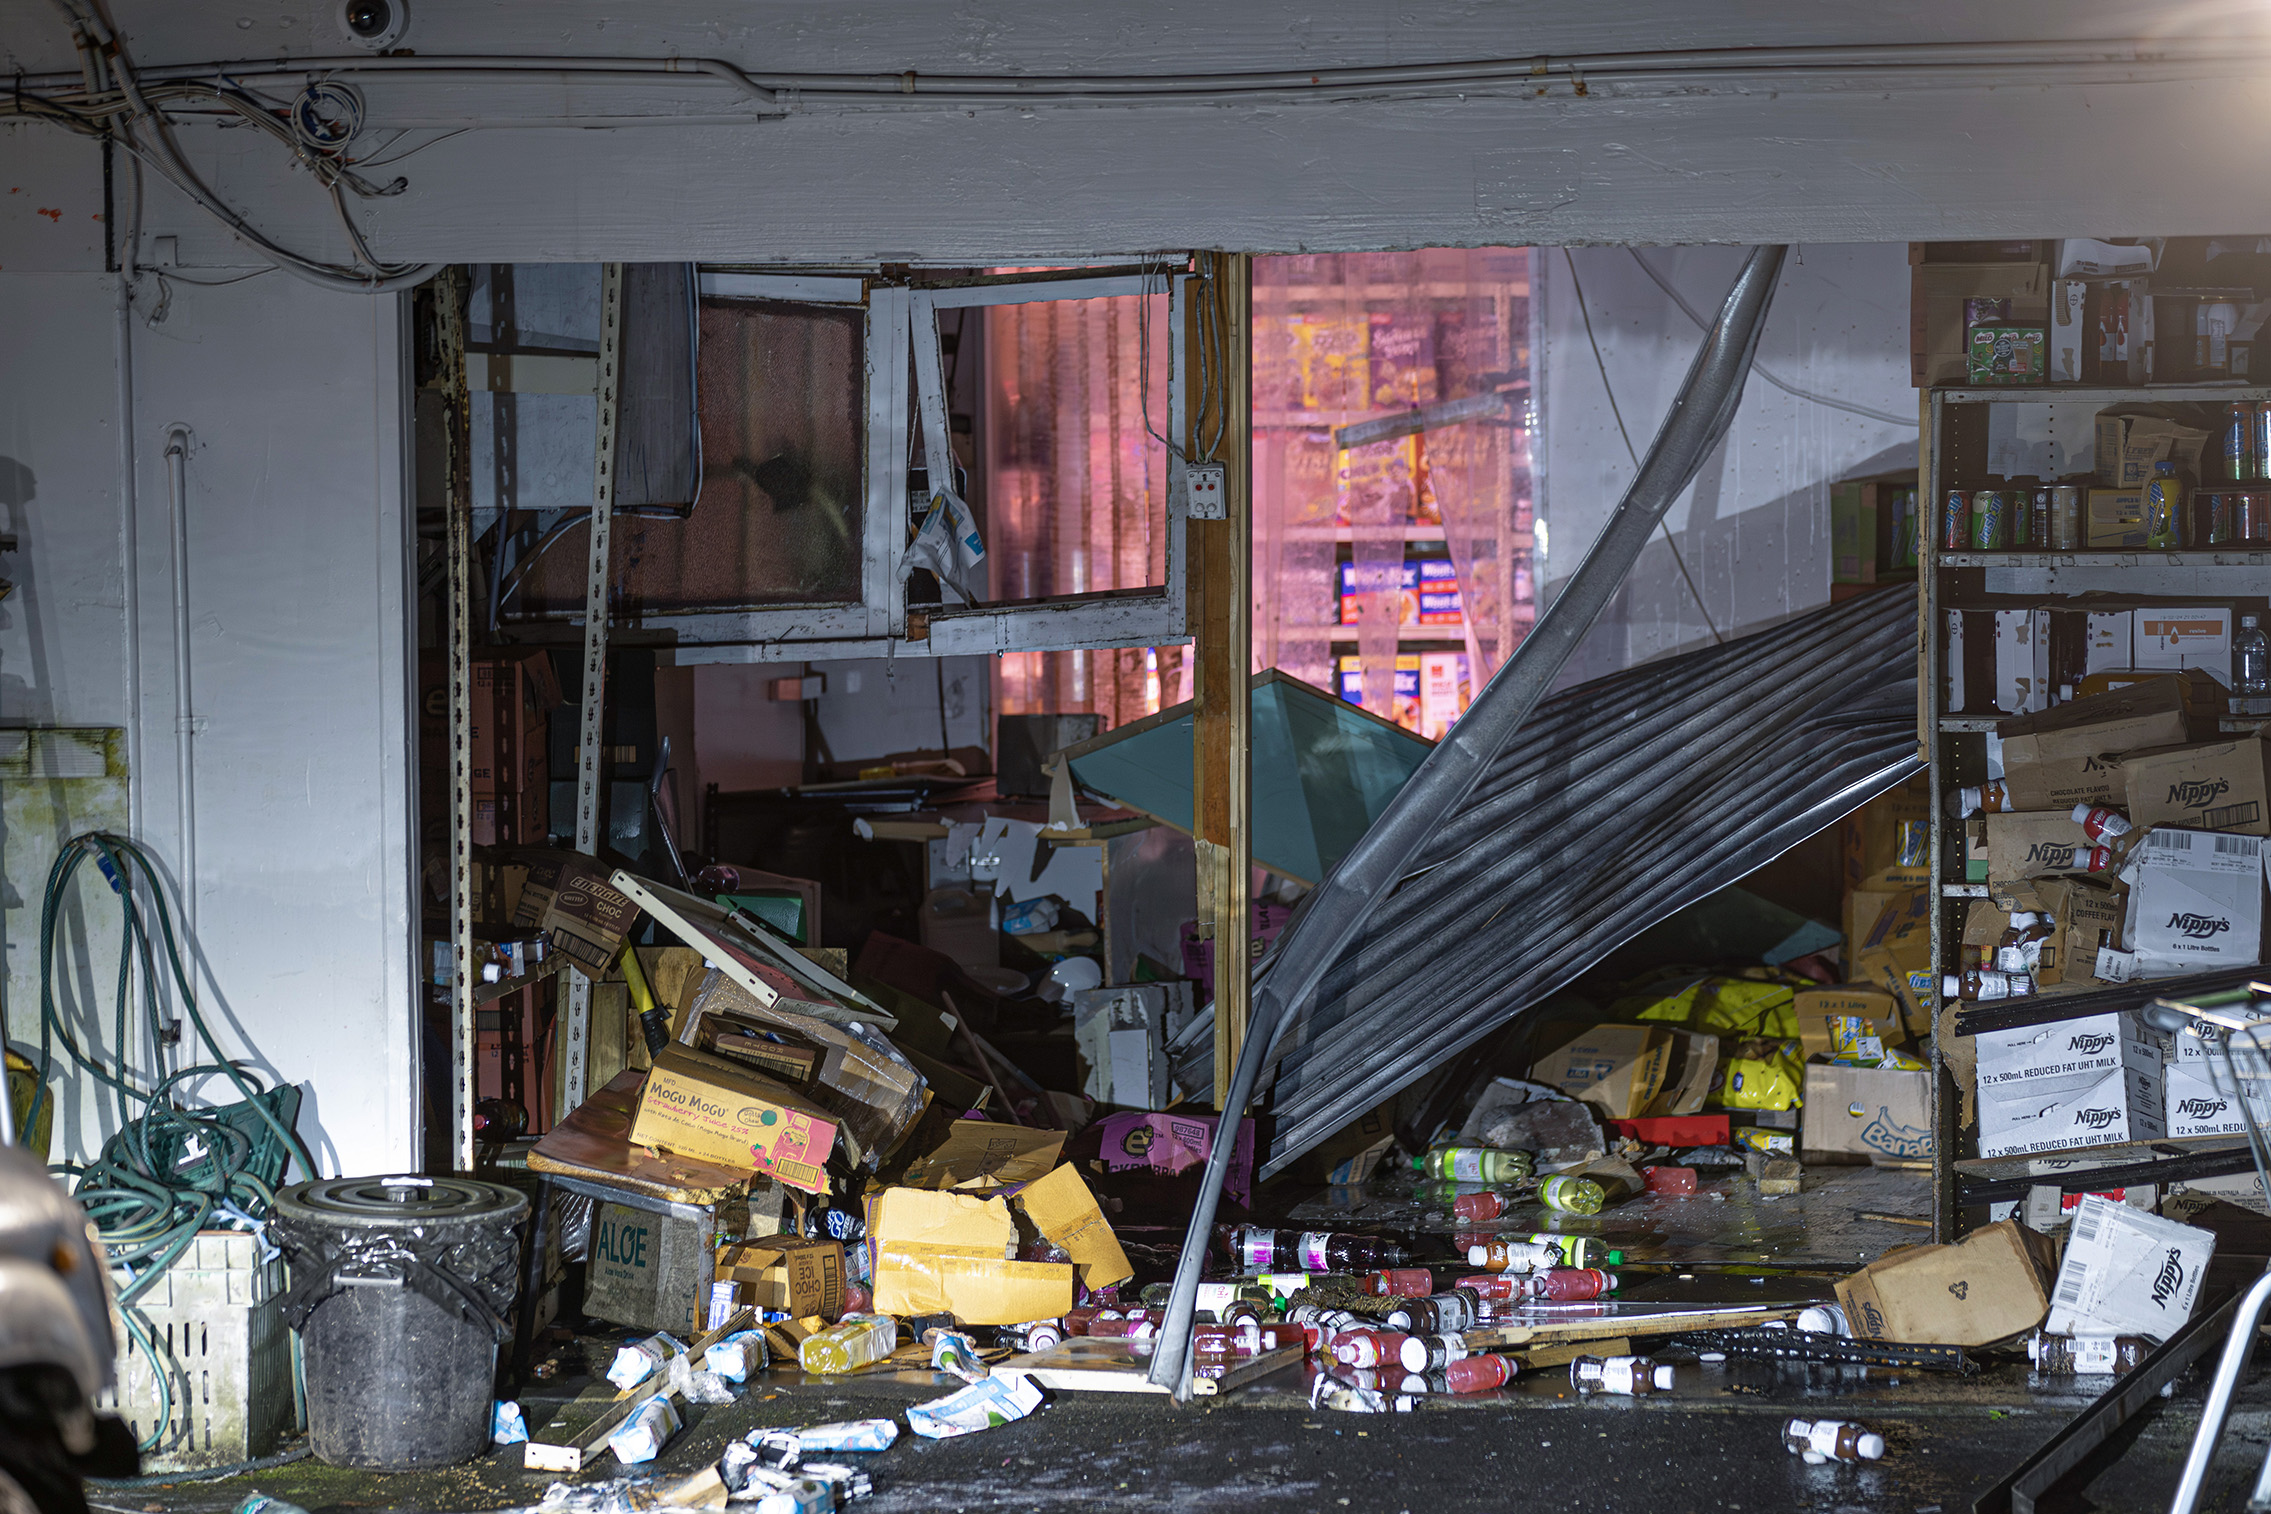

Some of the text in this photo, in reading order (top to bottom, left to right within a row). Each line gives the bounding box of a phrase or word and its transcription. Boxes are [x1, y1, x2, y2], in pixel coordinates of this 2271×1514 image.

[1976, 335, 1993, 343] MILO
[1978, 493, 2003, 545] fresh up
[2050, 788, 2085, 797] CHOCOLATE
[2052, 796, 2079, 804] REDUCED
[2165, 777, 2230, 810] Nippy's
[596, 901, 622, 918] CHOC
[2076, 909, 2100, 919] COFFEE
[2165, 912, 2231, 939] Nippy's
[1819, 1001, 1829, 1009] 12
[1848, 1001, 1867, 1009] Litre
[2067, 1032, 2115, 1056] Nippy's
[2184, 1048, 2191, 1056] 12
[663, 1077, 677, 1086] MFD
[1983, 1075, 1992, 1084] 12
[2000, 1070, 2023, 1083] 500mL
[2024, 1065, 2061, 1078] REDUCED
[2062, 1061, 2076, 1073] FAT
[2078, 1060, 2094, 1071] UHT
[2096, 1057, 2117, 1068] MILK
[646, 1096, 749, 1135] Strawberry Juice 25%
[2074, 1107, 2122, 1130] Nippy's
[2175, 1097, 2228, 1120] Nippy's
[2176, 1126, 2185, 1134] 12
[2194, 1124, 2221, 1134] 500mL
[1987, 1149, 1997, 1158] 12
[2004, 1144, 2028, 1155] 500mL
[2030, 1139, 2068, 1152] REDUCED
[2069, 1136, 2084, 1147] FAT
[2085, 1134, 2102, 1145] UHT
[2103, 1132, 2124, 1143] MILK
[710, 1153, 735, 1163] BOTTLES
[830, 1210, 845, 1239] GO
[597, 1221, 648, 1268] ALOE
[799, 1266, 815, 1280] ICE
[2151, 1246, 2184, 1311] Nippy's
[2186, 1284, 2194, 1297] Litre
[2190, 1265, 2200, 1284] Bottles
[795, 1279, 821, 1295] CHOC
[1861, 1301, 1886, 1340] Nippy's
